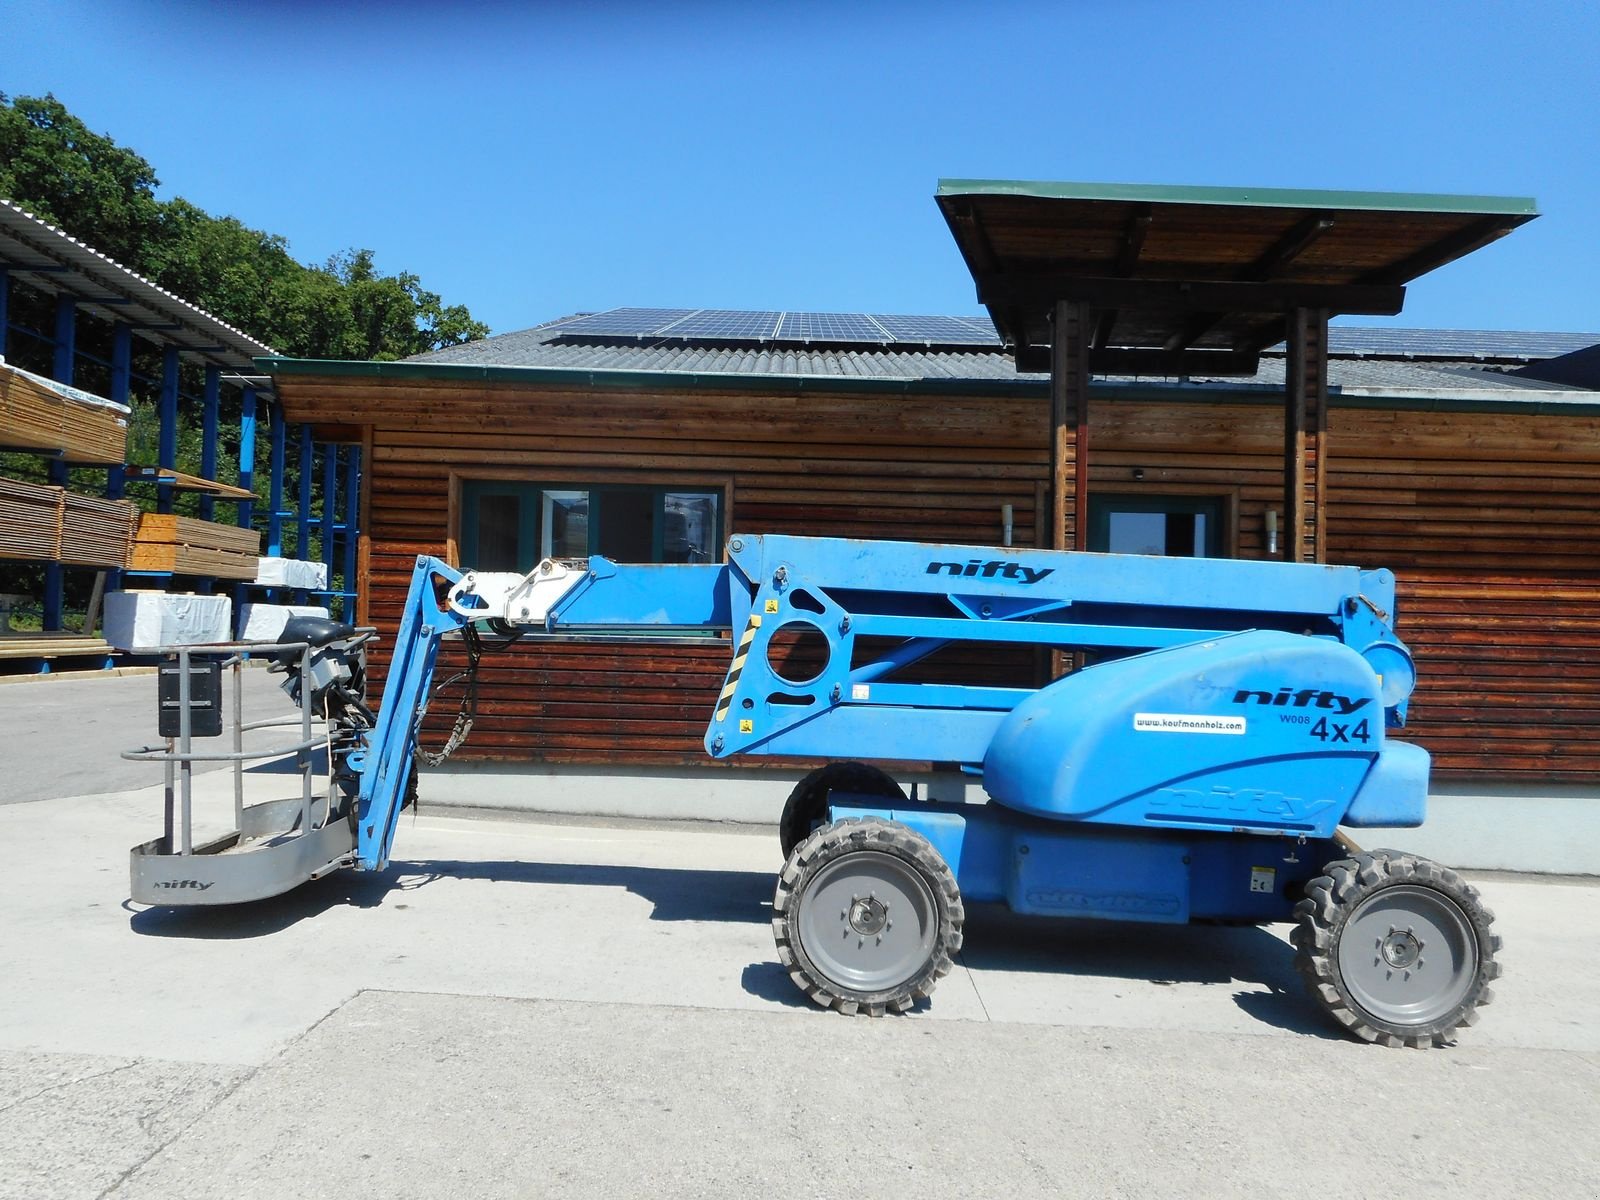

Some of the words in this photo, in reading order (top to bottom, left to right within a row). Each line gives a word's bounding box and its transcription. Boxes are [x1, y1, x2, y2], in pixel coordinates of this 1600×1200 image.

[926, 559, 1056, 584] nifty
[1232, 687, 1374, 714] nifty
[1137, 719, 1242, 730] www.kaufmannholz.com
[1280, 714, 1310, 724] W008
[1310, 716, 1371, 744] 4x4
